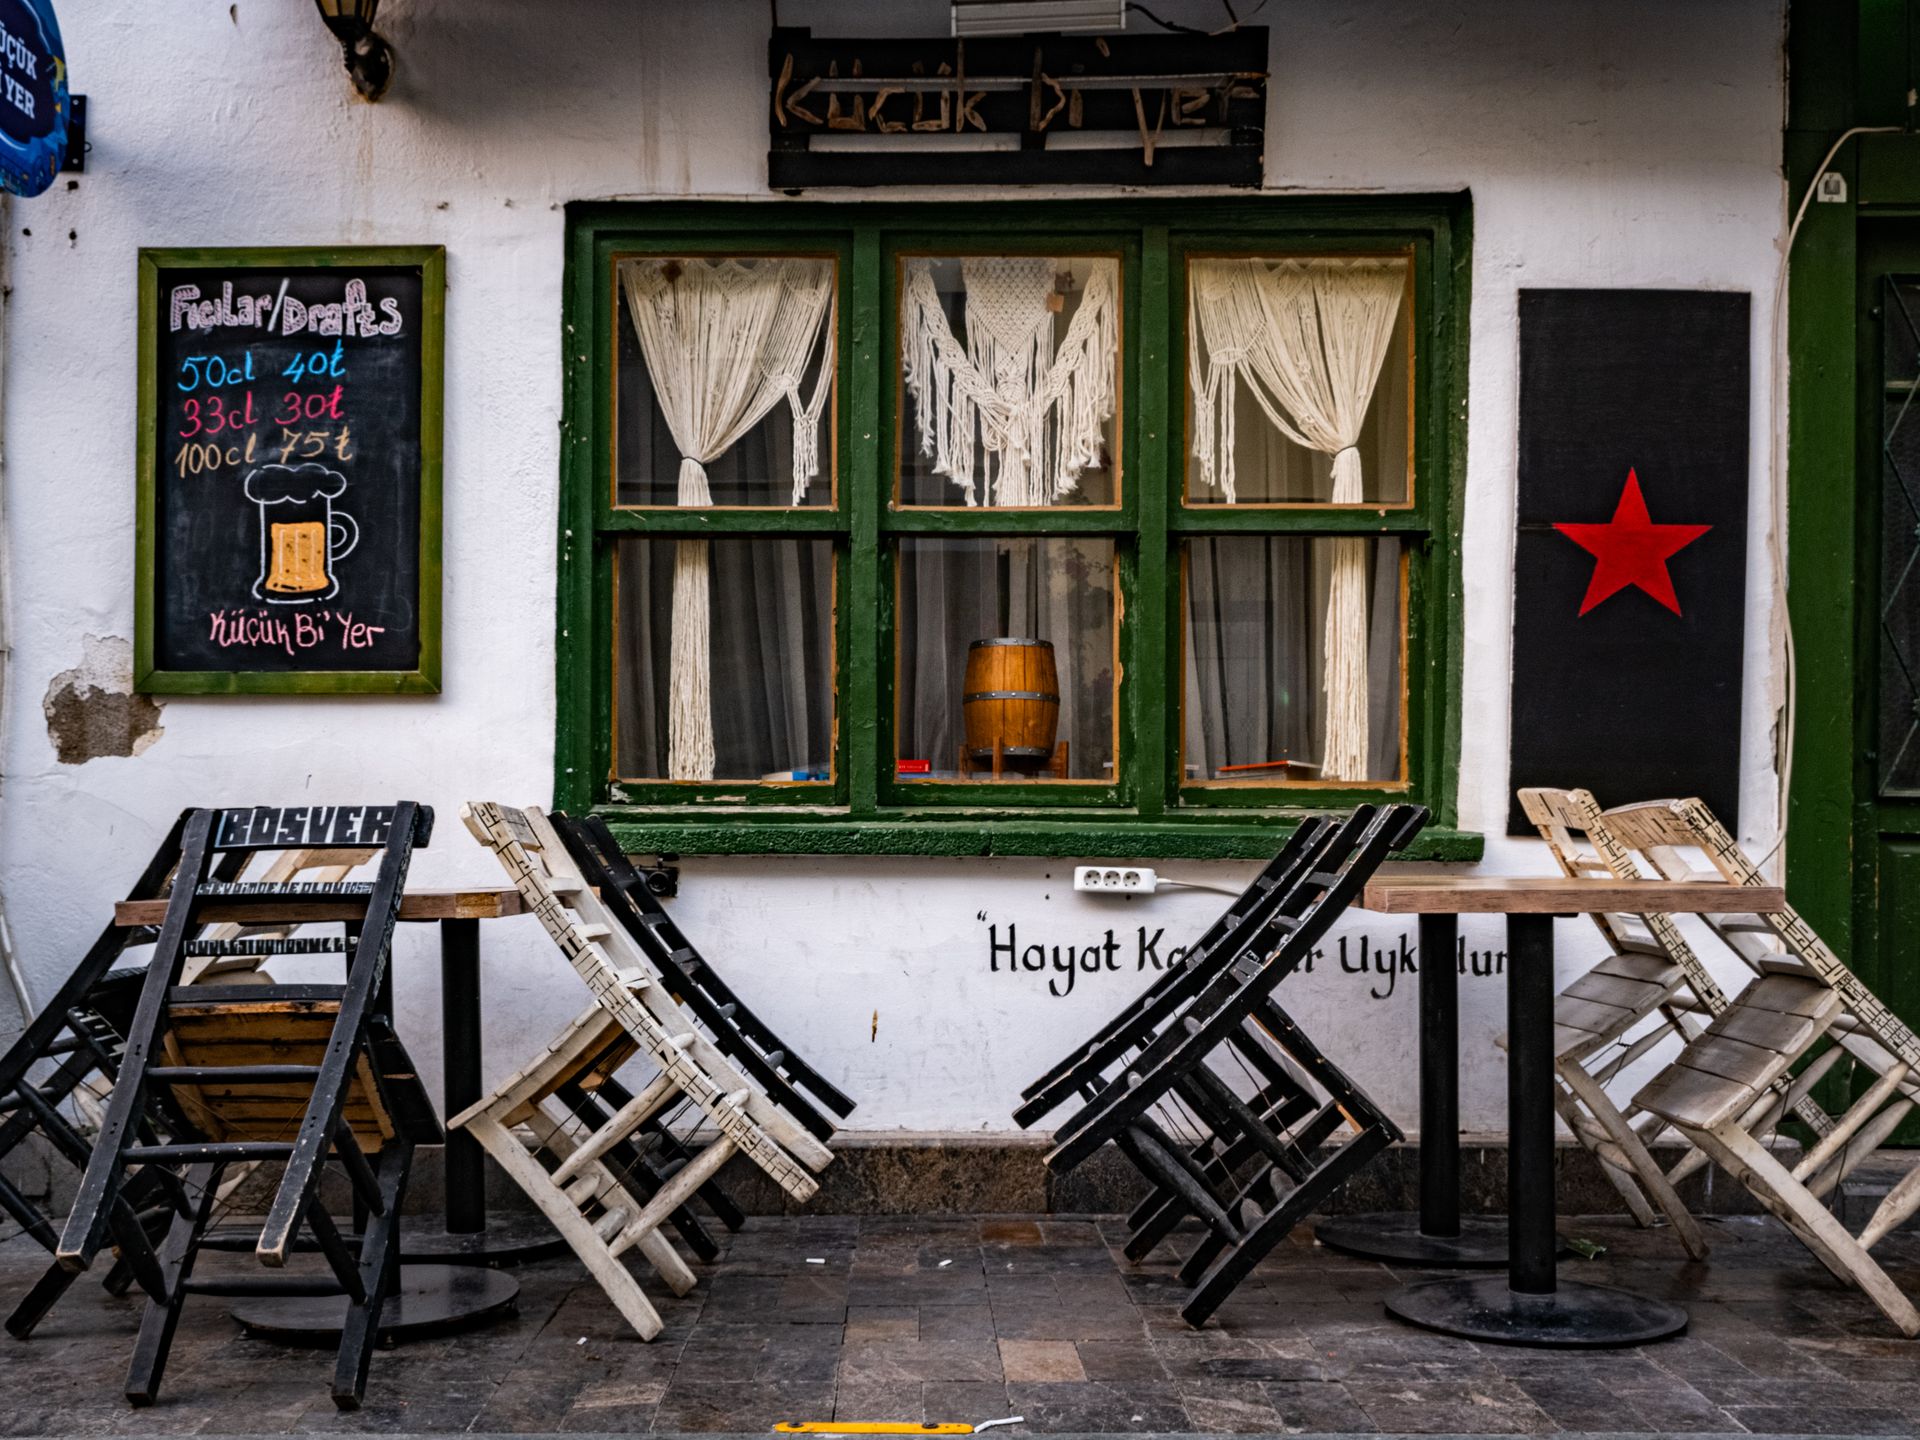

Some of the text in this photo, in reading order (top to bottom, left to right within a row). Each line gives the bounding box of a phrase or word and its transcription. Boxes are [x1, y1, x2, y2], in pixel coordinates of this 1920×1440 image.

[4, 73, 36, 119] YER
[177, 351, 256, 391] 50cl
[179, 391, 258, 438] 33cl
[336, 611, 385, 650] Yer
